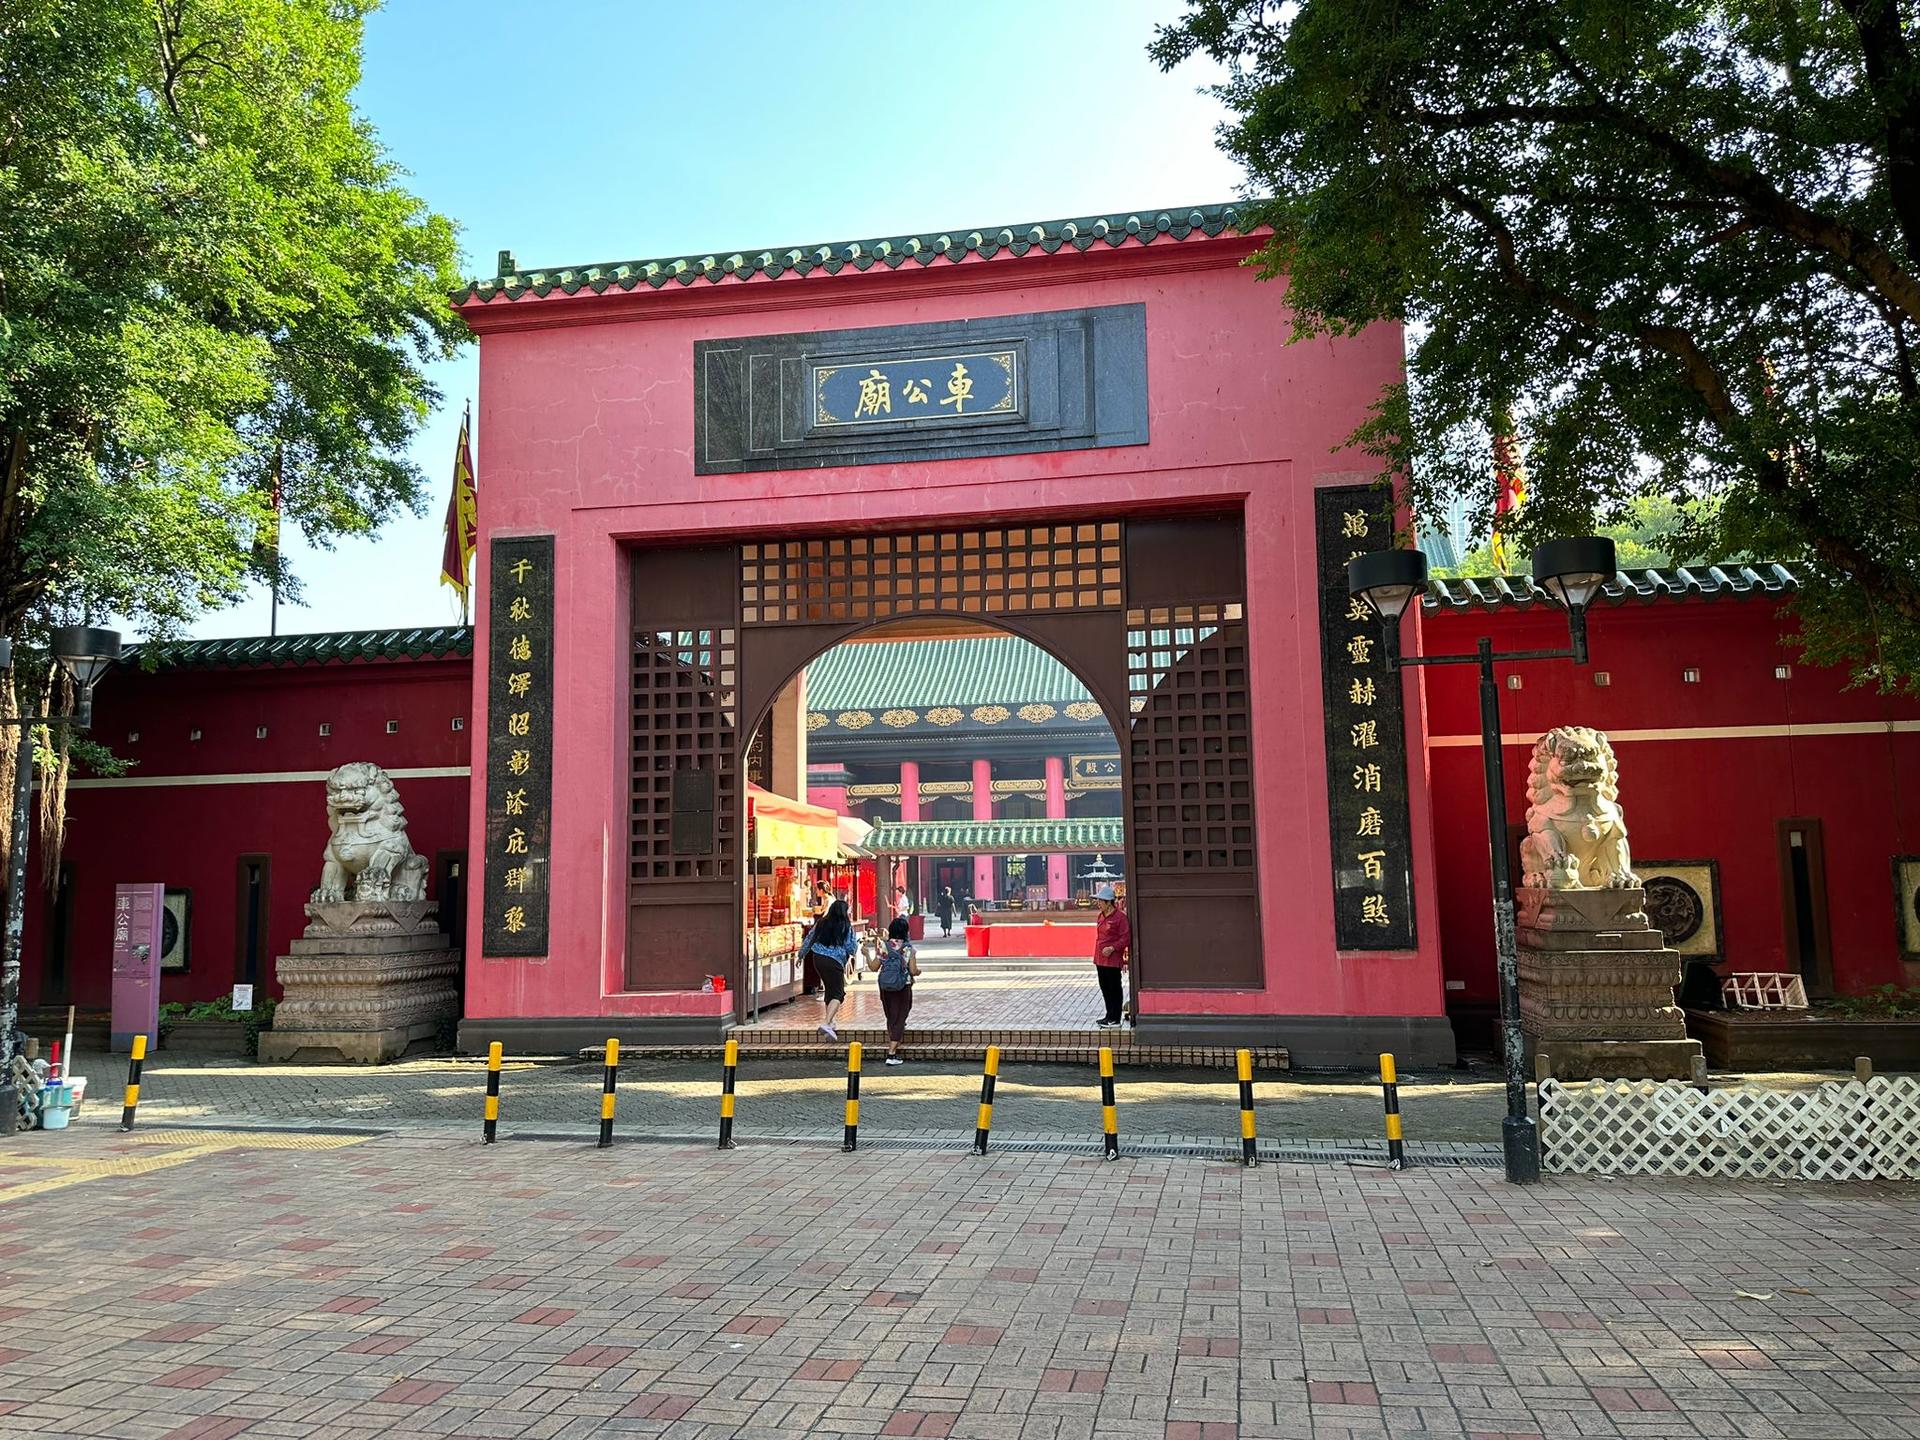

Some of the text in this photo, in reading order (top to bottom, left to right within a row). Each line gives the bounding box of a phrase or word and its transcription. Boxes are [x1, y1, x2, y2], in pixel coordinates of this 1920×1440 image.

[1341, 508, 1391, 927] 萬英靈赫濯消磨百煞
[115, 896, 130, 941] 車公廟
